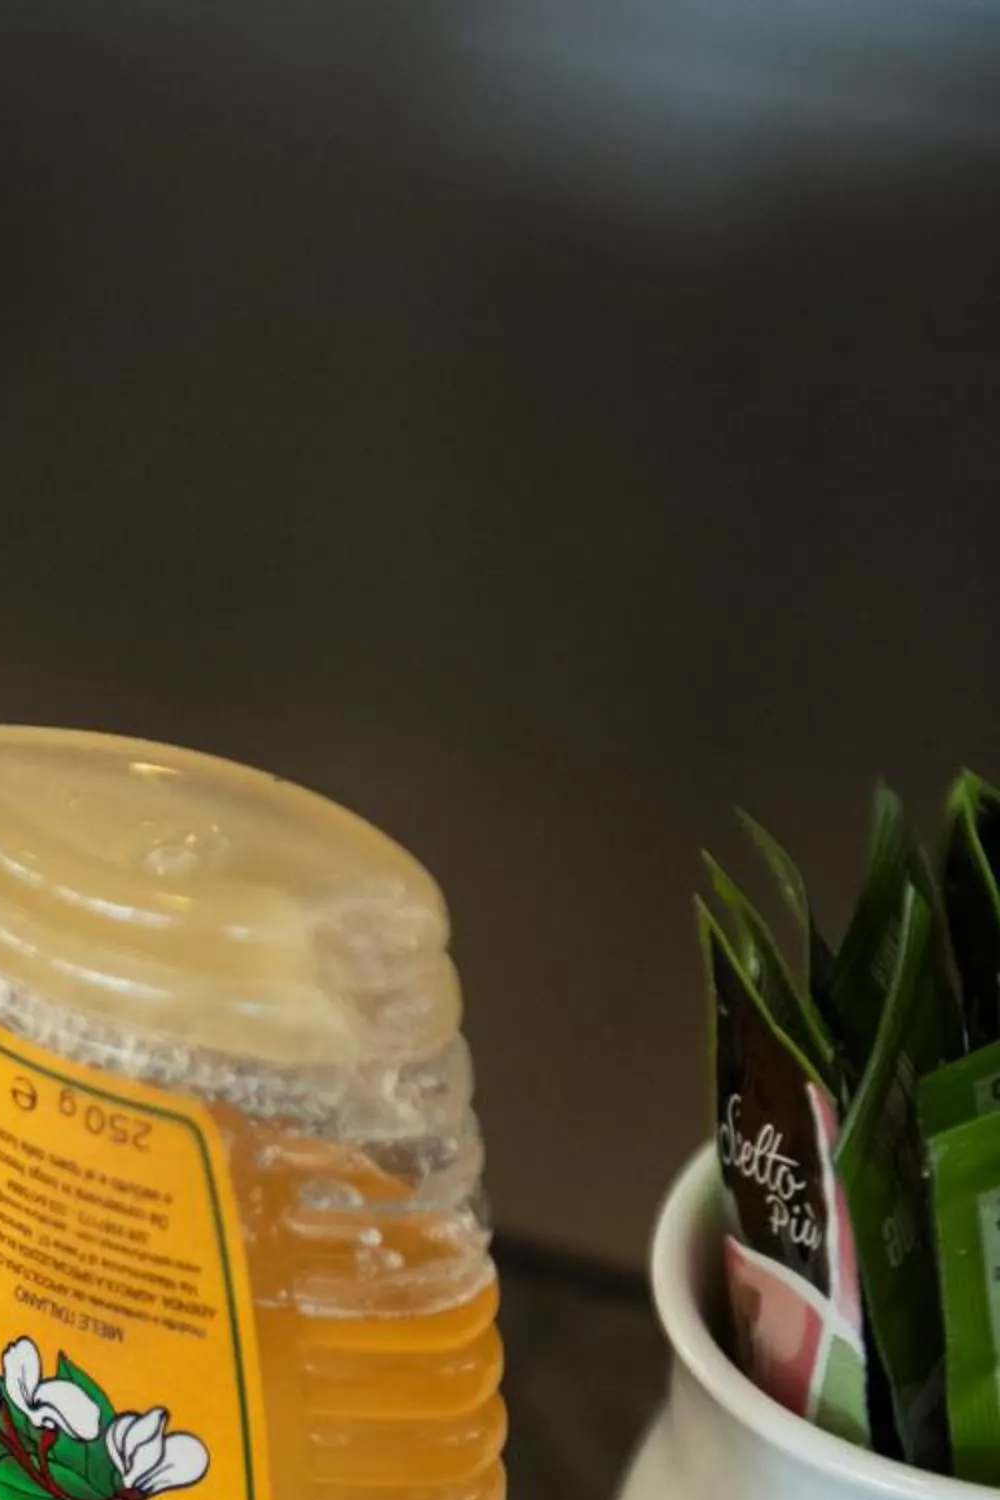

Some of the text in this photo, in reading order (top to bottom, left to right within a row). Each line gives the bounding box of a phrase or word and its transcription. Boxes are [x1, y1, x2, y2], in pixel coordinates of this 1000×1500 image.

[57, 1088, 77, 1118] g
[83, 1106, 153, 1152] 250
[765, 1194, 822, 1249] Più
